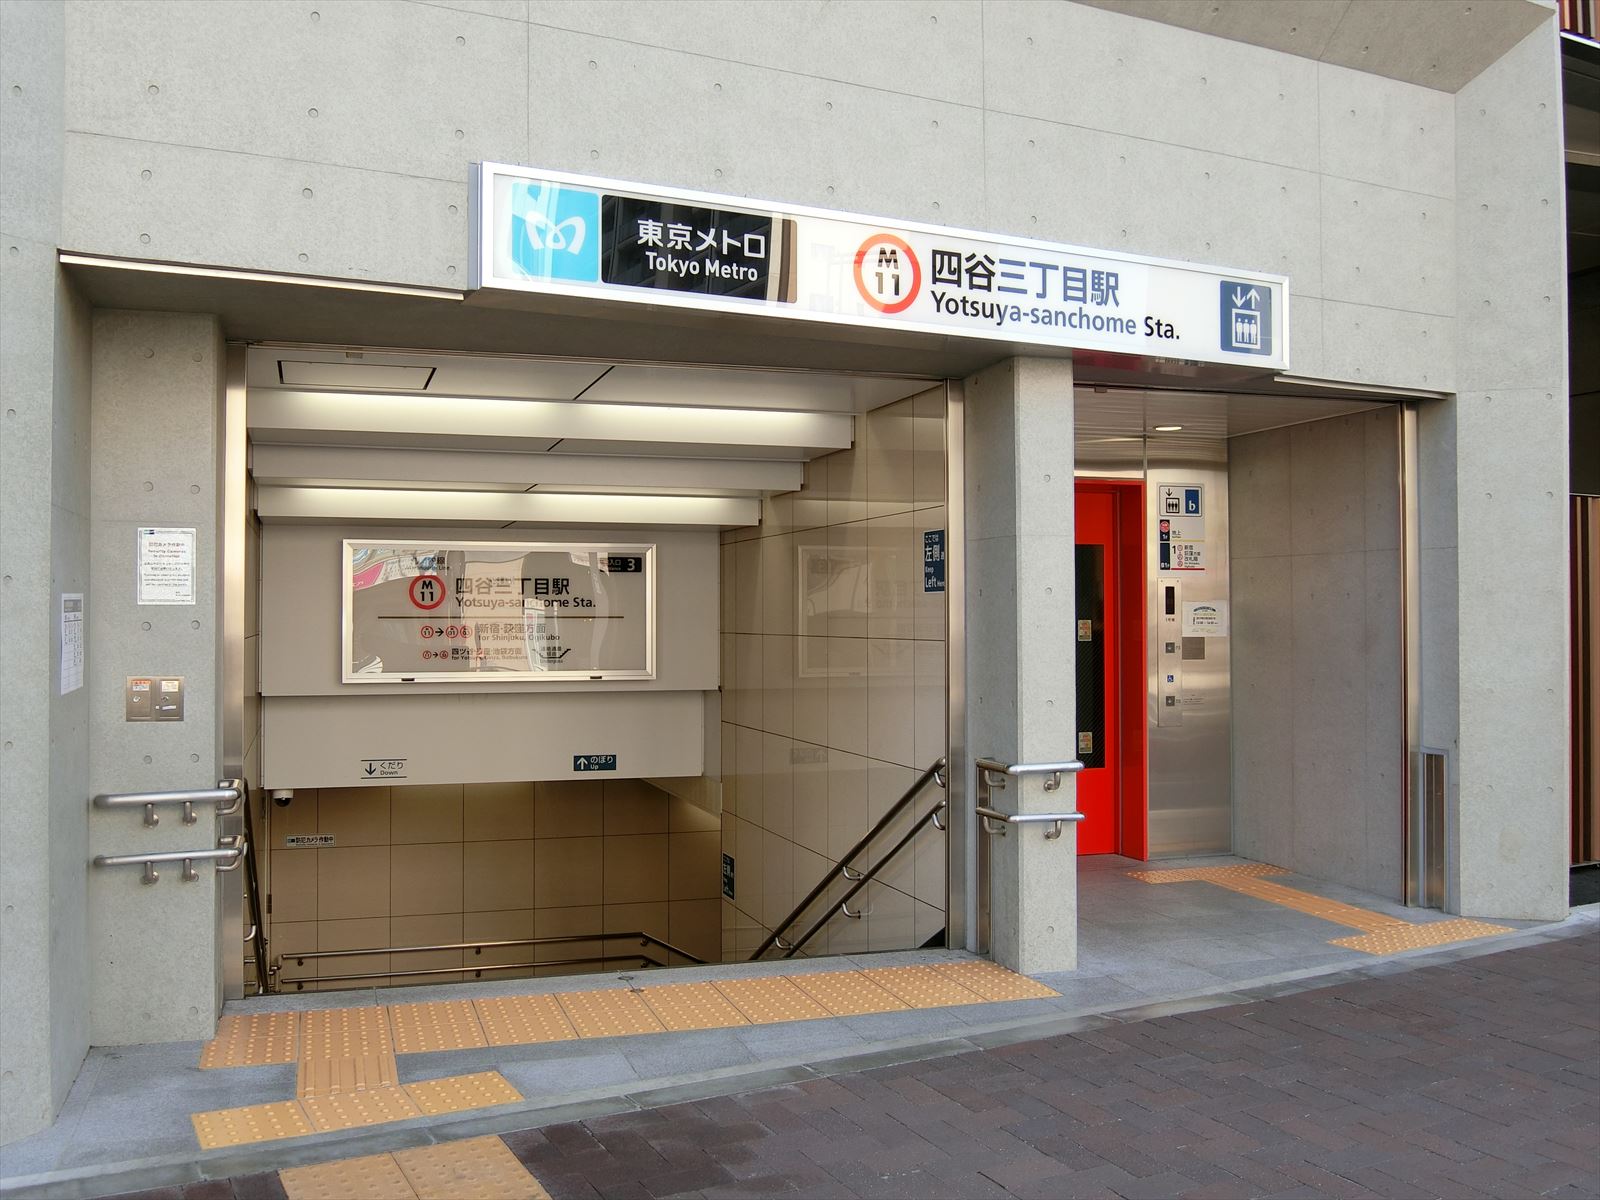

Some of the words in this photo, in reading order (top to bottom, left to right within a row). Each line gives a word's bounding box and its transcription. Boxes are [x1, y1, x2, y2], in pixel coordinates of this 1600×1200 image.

[637, 219, 766, 259] 東京メトロ
[877, 247, 899, 270] M
[645, 251, 700, 278] Tokyo
[705, 258, 758, 282] Metro
[875, 271, 900, 297] 11
[931, 249, 1120, 308] 四谷三丁目駅
[930, 290, 1137, 336] Yotsuya-sanchome
[1144, 316, 1181, 341] Sta.
[1188, 500, 1196, 511] b
[627, 558, 635, 571] 3
[421, 580, 433, 590] M
[455, 577, 570, 596] 四谷三丁目駅
[925, 576, 937, 588] Left
[420, 591, 434, 602] 11
[573, 597, 596, 608] Sta.
[380, 761, 404, 770] くだり
[590, 756, 614, 764] のぼり
